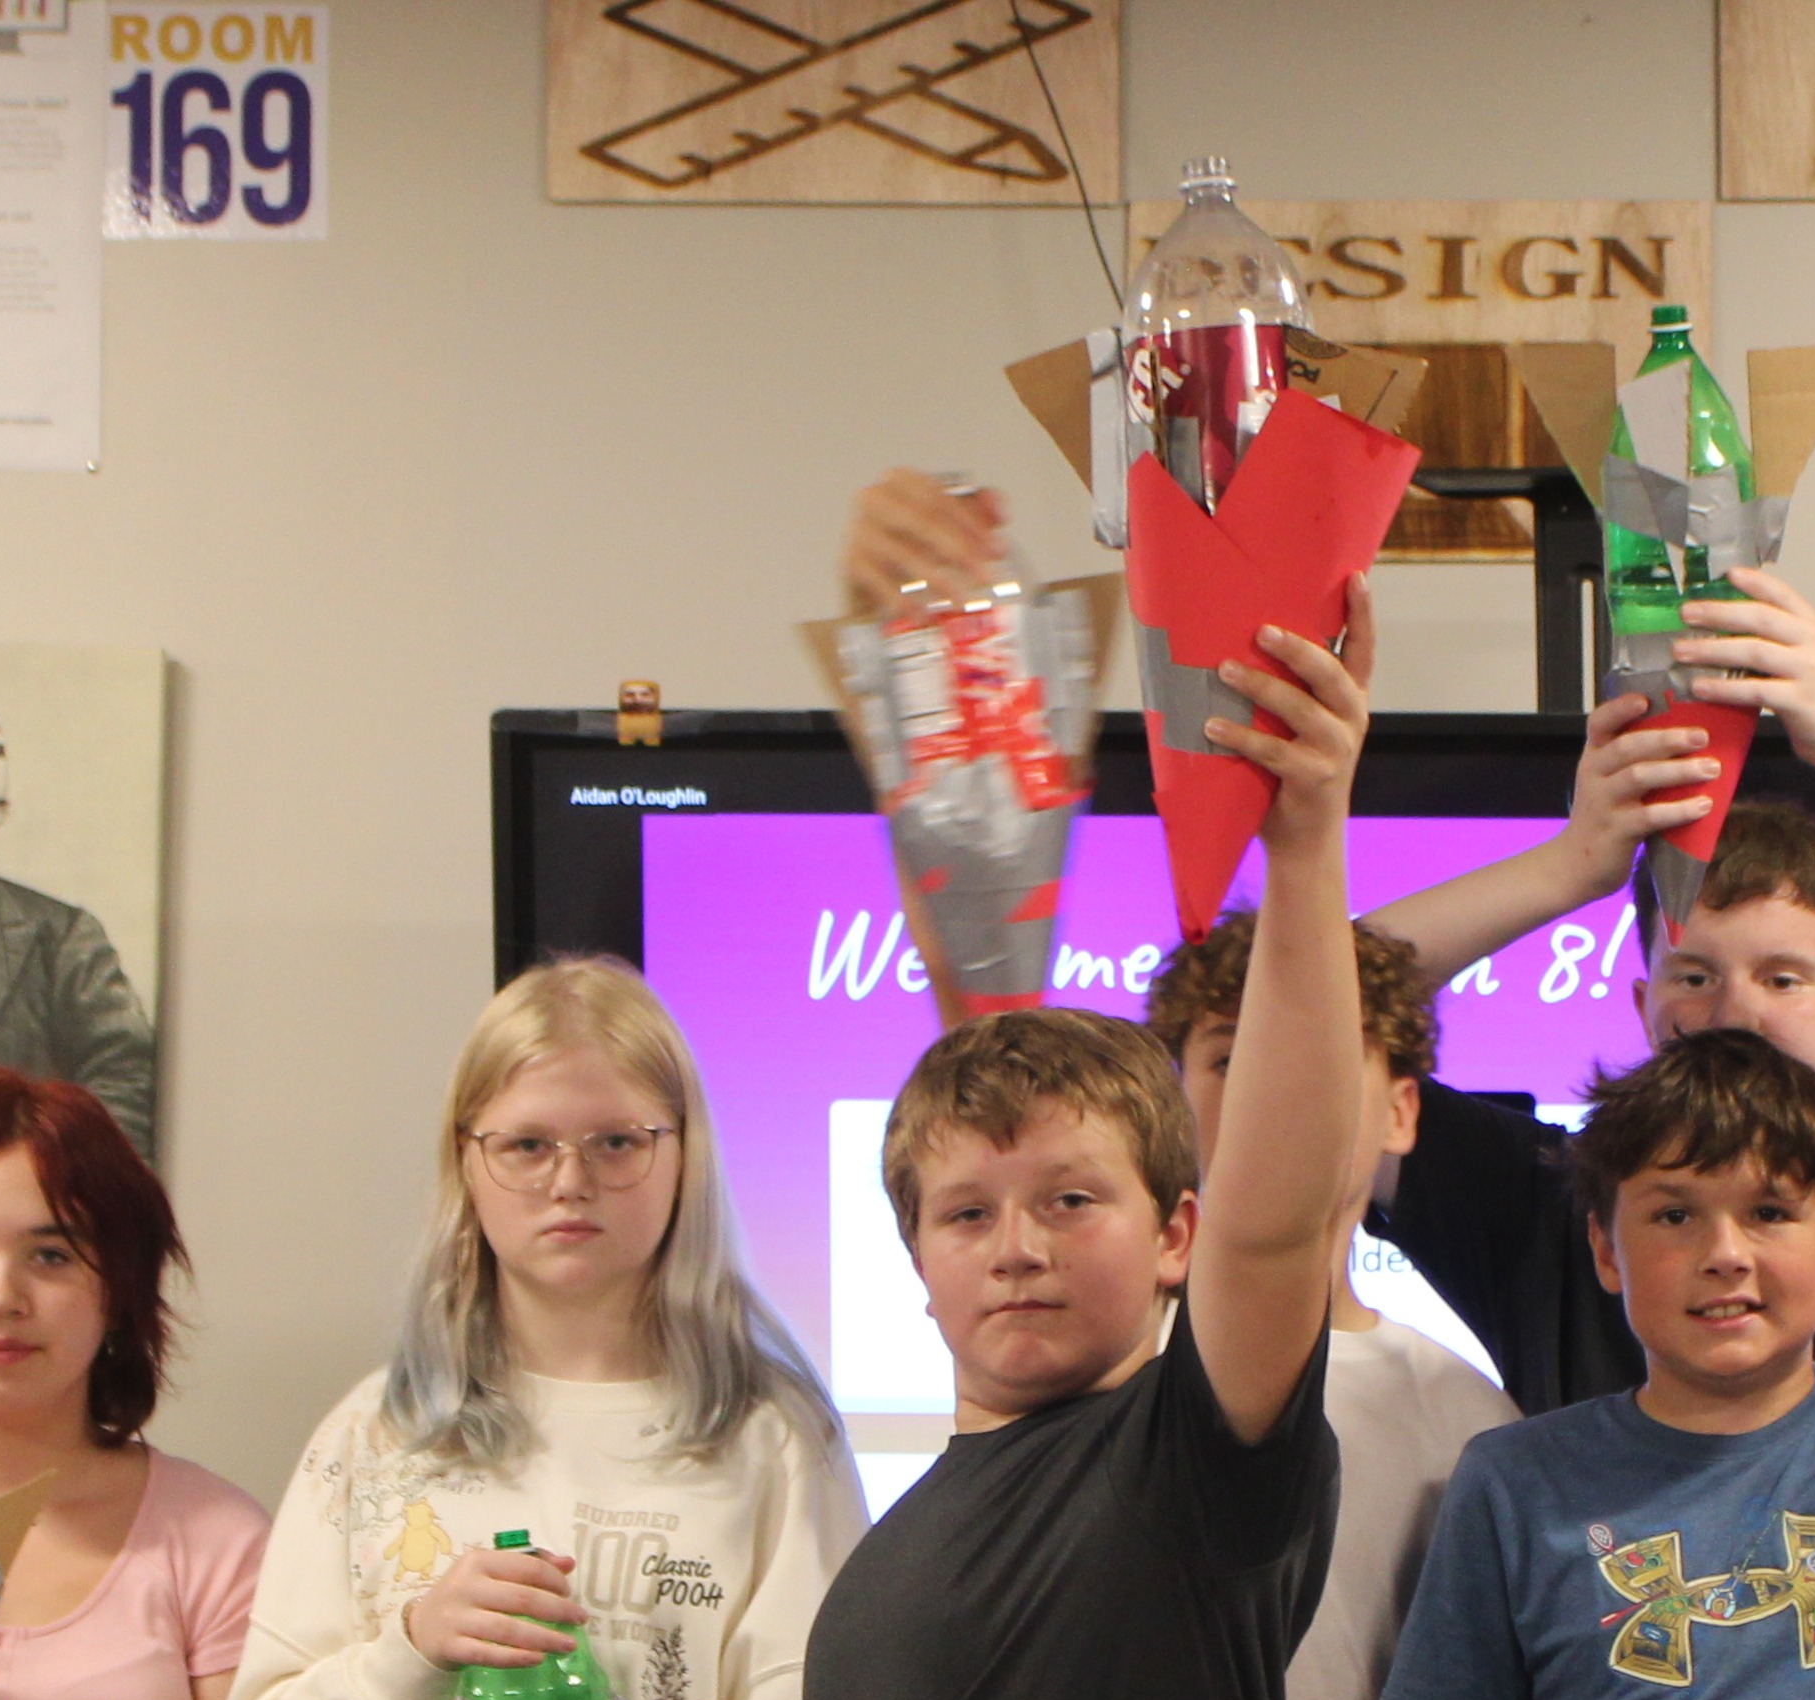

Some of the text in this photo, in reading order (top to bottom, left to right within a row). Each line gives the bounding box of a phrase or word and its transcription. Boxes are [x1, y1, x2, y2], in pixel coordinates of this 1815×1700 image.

[110, 14, 313, 63] ROOM
[111, 69, 312, 228] 169
[1140, 235, 1673, 300] SIGN
[570, 786, 707, 809] Aidan O'Loughlin
[1539, 903, 1637, 1003] 8!
[572, 1501, 680, 1533] HUNDRED
[641, 1551, 714, 1578] Classic
